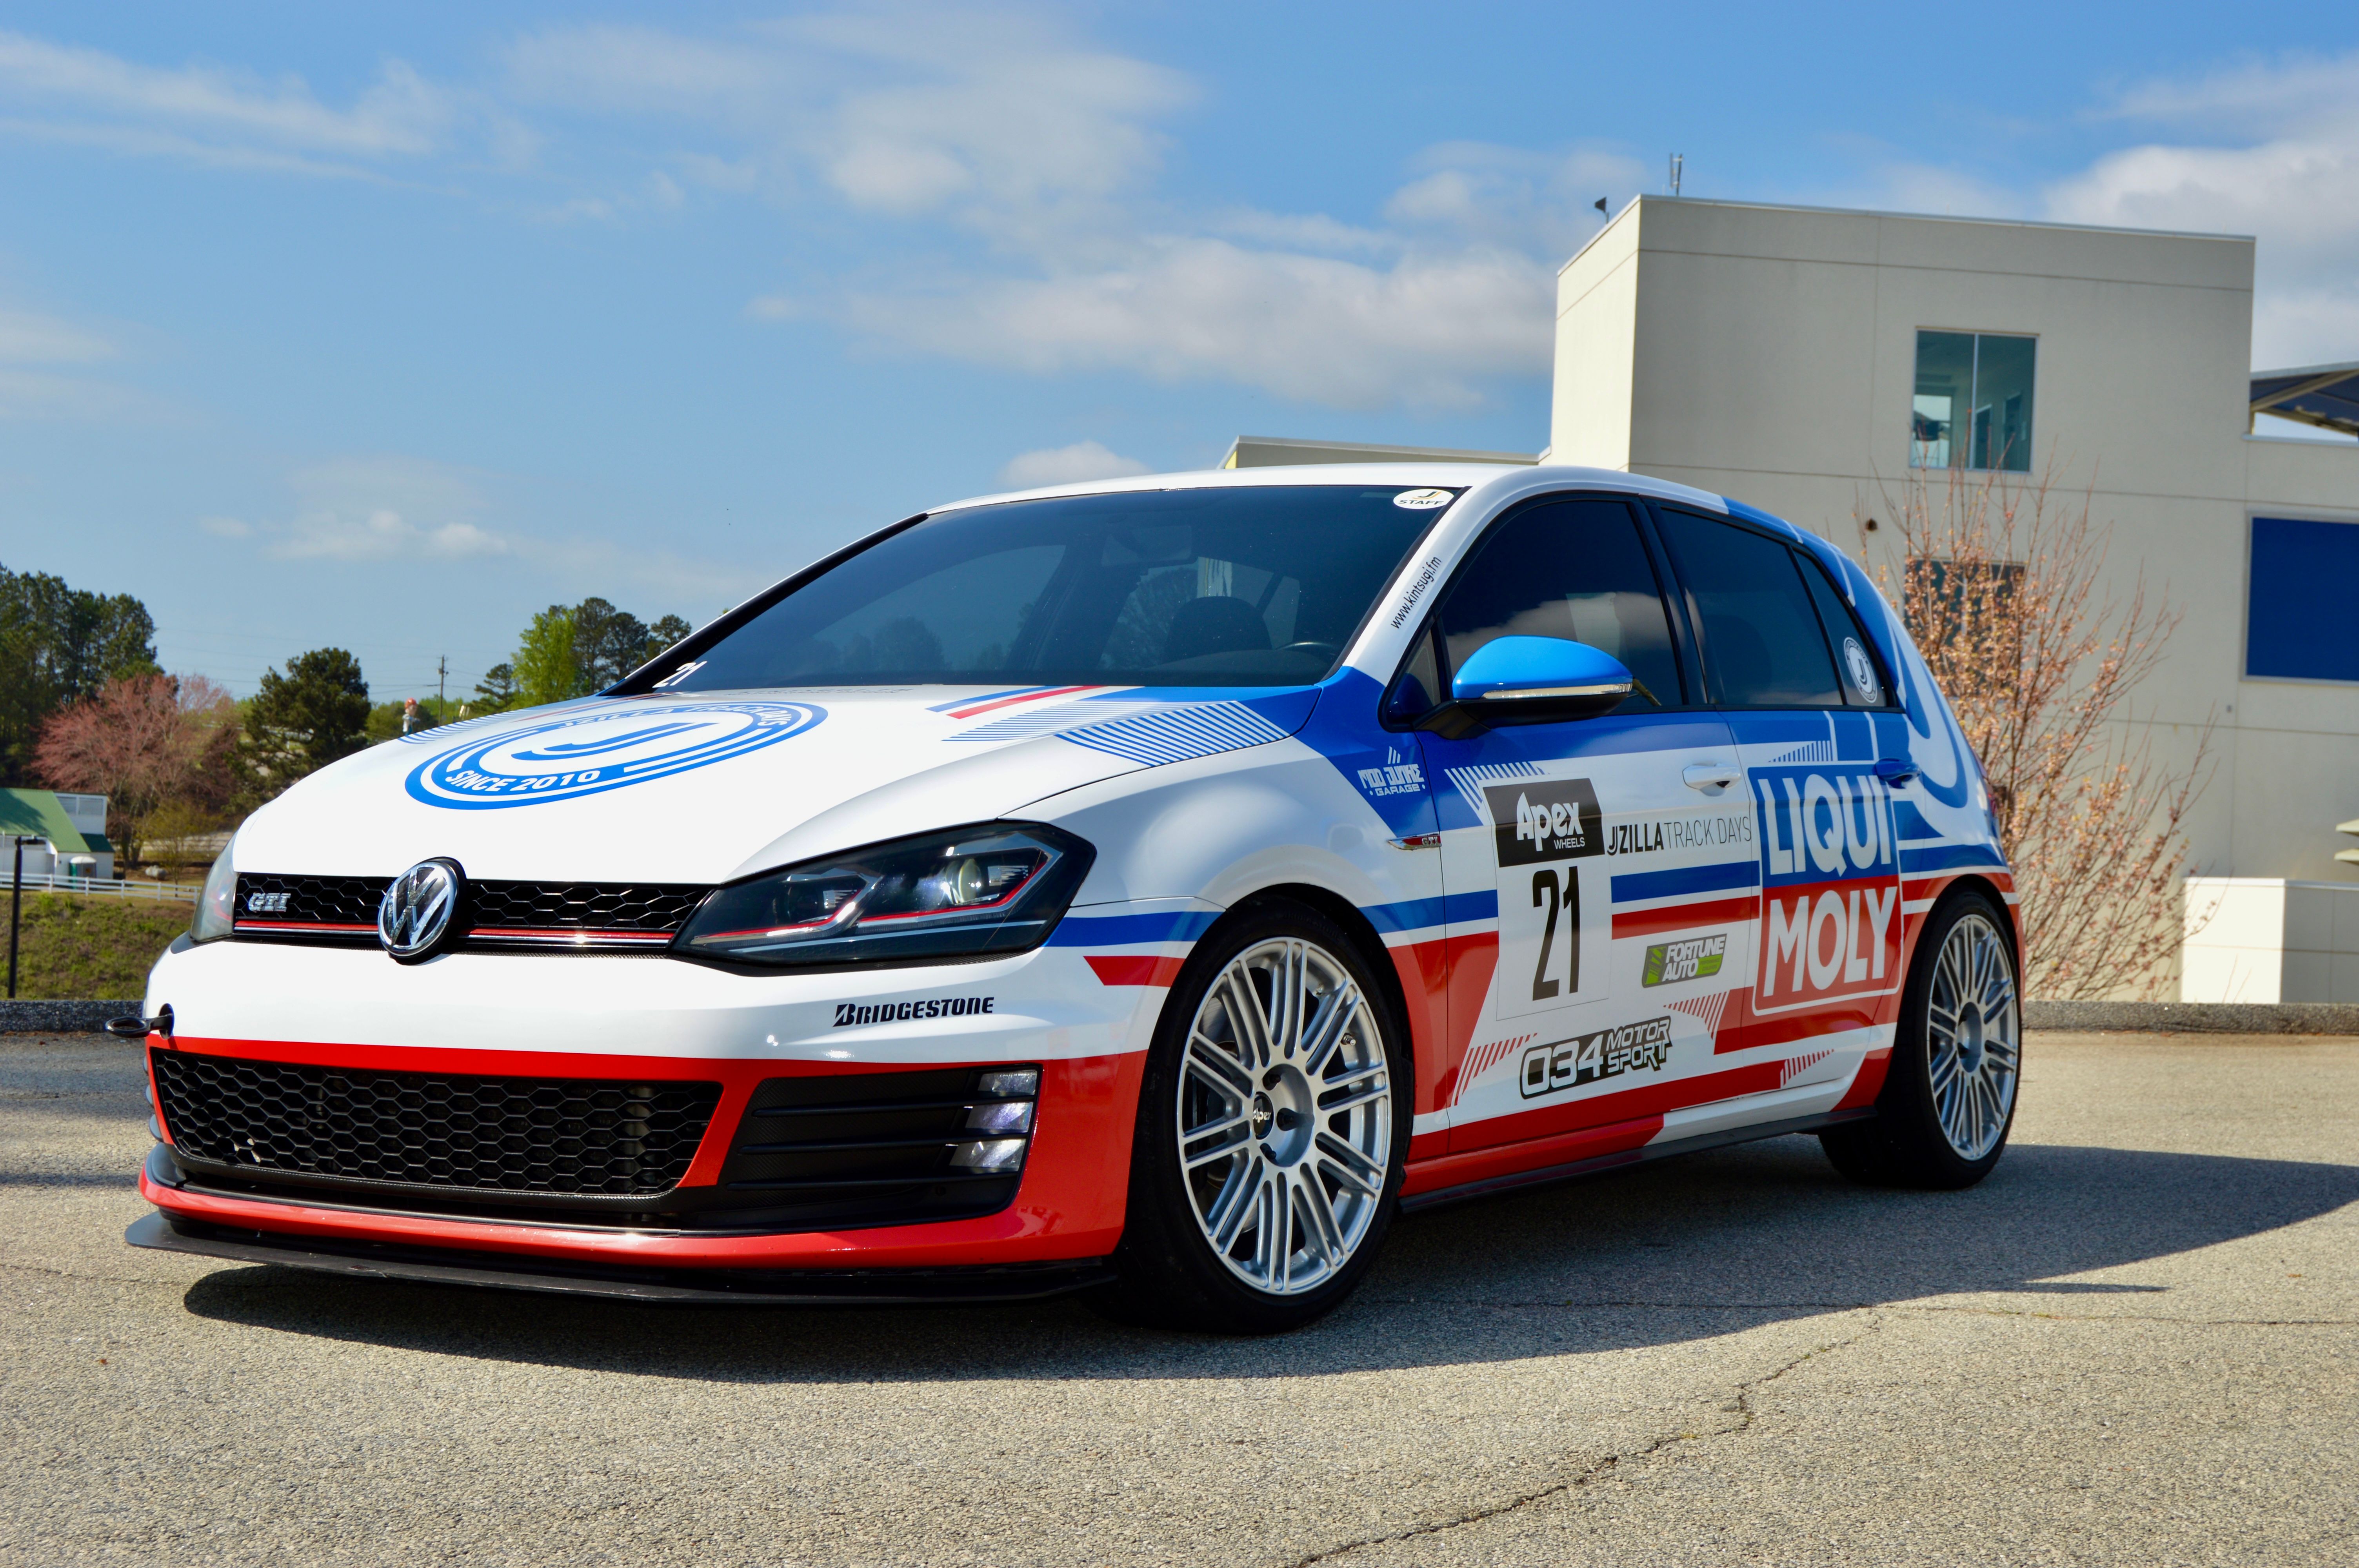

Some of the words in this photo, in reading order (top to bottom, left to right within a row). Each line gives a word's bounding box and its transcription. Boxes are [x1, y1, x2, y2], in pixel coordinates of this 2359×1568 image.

[1390, 556, 1442, 629] www.kintsugi.fm
[652, 661, 707, 688] 21
[558, 708, 675, 728] JZILLA
[754, 710, 793, 726] DAYS
[445, 770, 517, 791] SINCE
[509, 770, 600, 791] 2010
[1357, 768, 1387, 789] MOD
[1374, 783, 1421, 797] GARAGE
[1516, 792, 1584, 851] Apex
[1717, 817, 1752, 844] DAYS
[1758, 774, 1891, 877] LIQUI
[1421, 836, 1439, 846] GTI
[1554, 837, 1585, 849] WHEELS
[248, 891, 291, 913] GTI
[1532, 866, 1580, 1002] 21
[1763, 886, 1898, 997] MOLY
[1666, 936, 1725, 963] FORTUNE
[1662, 958, 1699, 982] AUTO
[832, 997, 994, 1027] BRIDGESTONE
[1607, 1018, 1670, 1051] MOTOR
[1521, 1035, 1604, 1096] 034
[1607, 1040, 1669, 1073] SPORT
